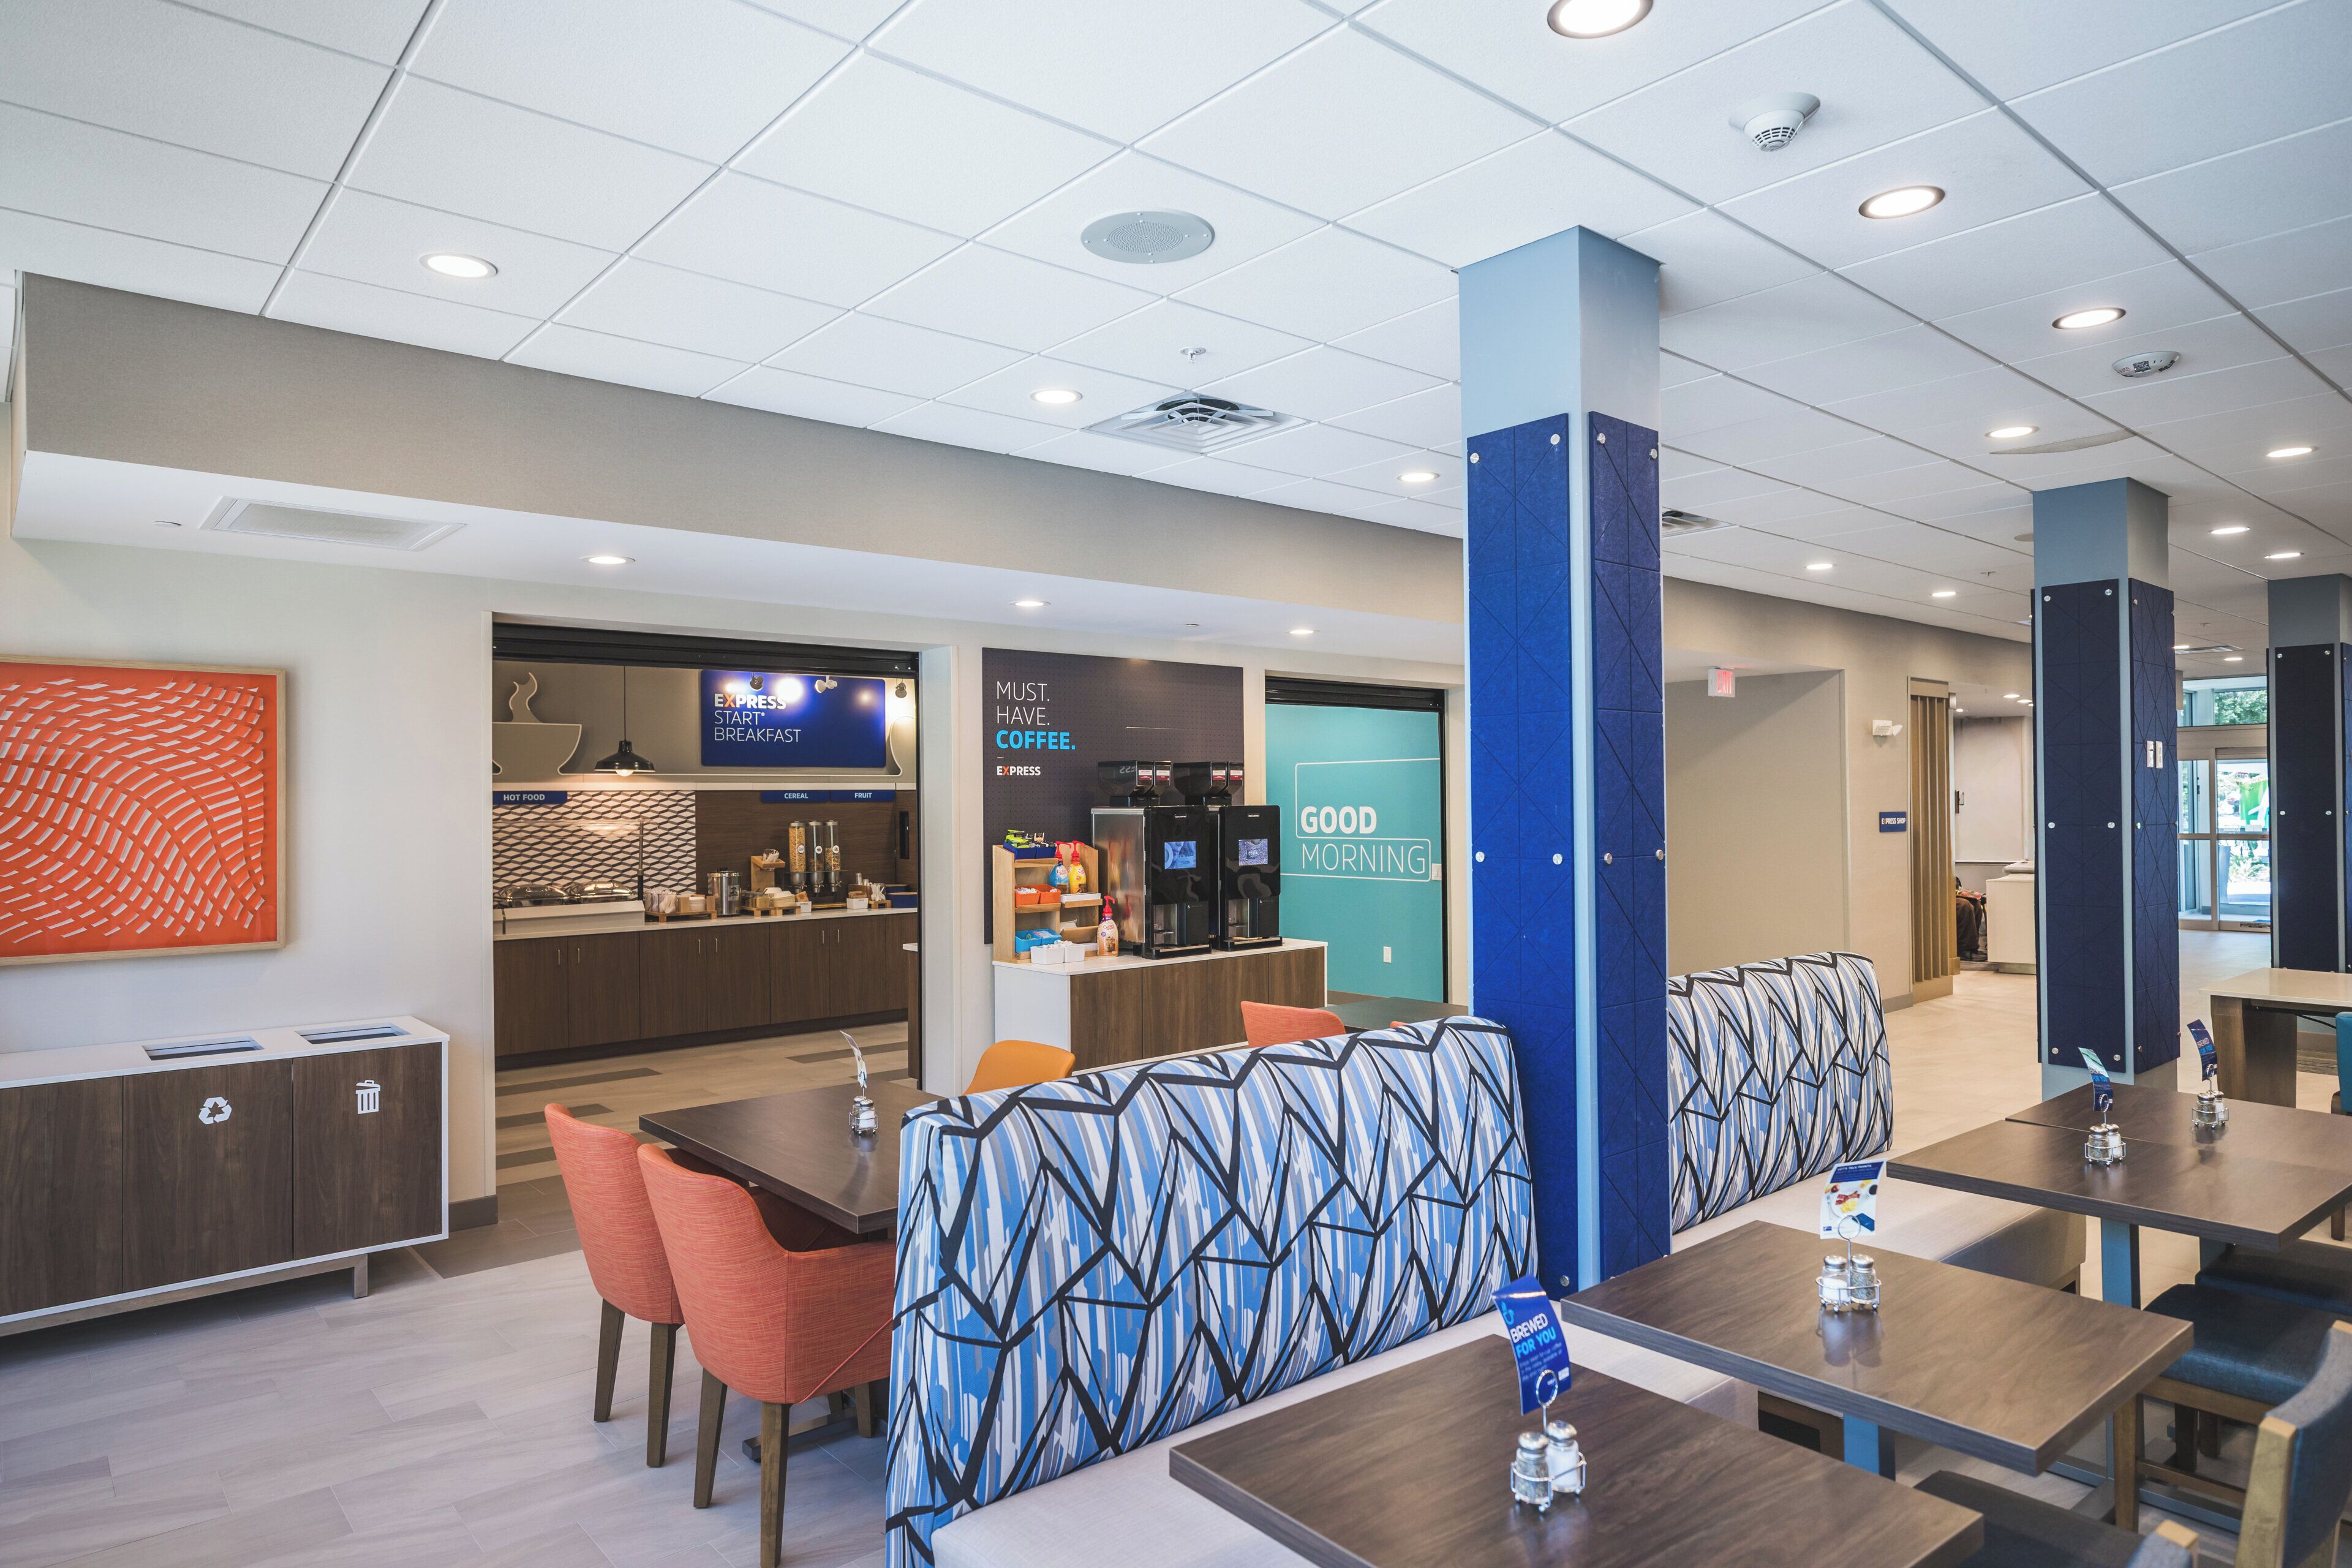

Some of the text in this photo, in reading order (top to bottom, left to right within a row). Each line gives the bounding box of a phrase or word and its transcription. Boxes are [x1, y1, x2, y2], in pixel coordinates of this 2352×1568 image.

[997, 680, 1050, 702] MUST.
[1717, 670, 1733, 694] EXIT
[714, 693, 786, 709] EXPRESS
[997, 705, 1050, 726] HAVE.
[714, 727, 802, 742] BREAKFAST
[996, 729, 1076, 750] COFFEE.
[997, 766, 1041, 776] EXPRESS
[1300, 806, 1377, 834] GOOD
[1302, 843, 1426, 874] MORNING
[1510, 1313, 1548, 1343] BREWED
[1516, 1326, 1556, 1359] FOR YOU
